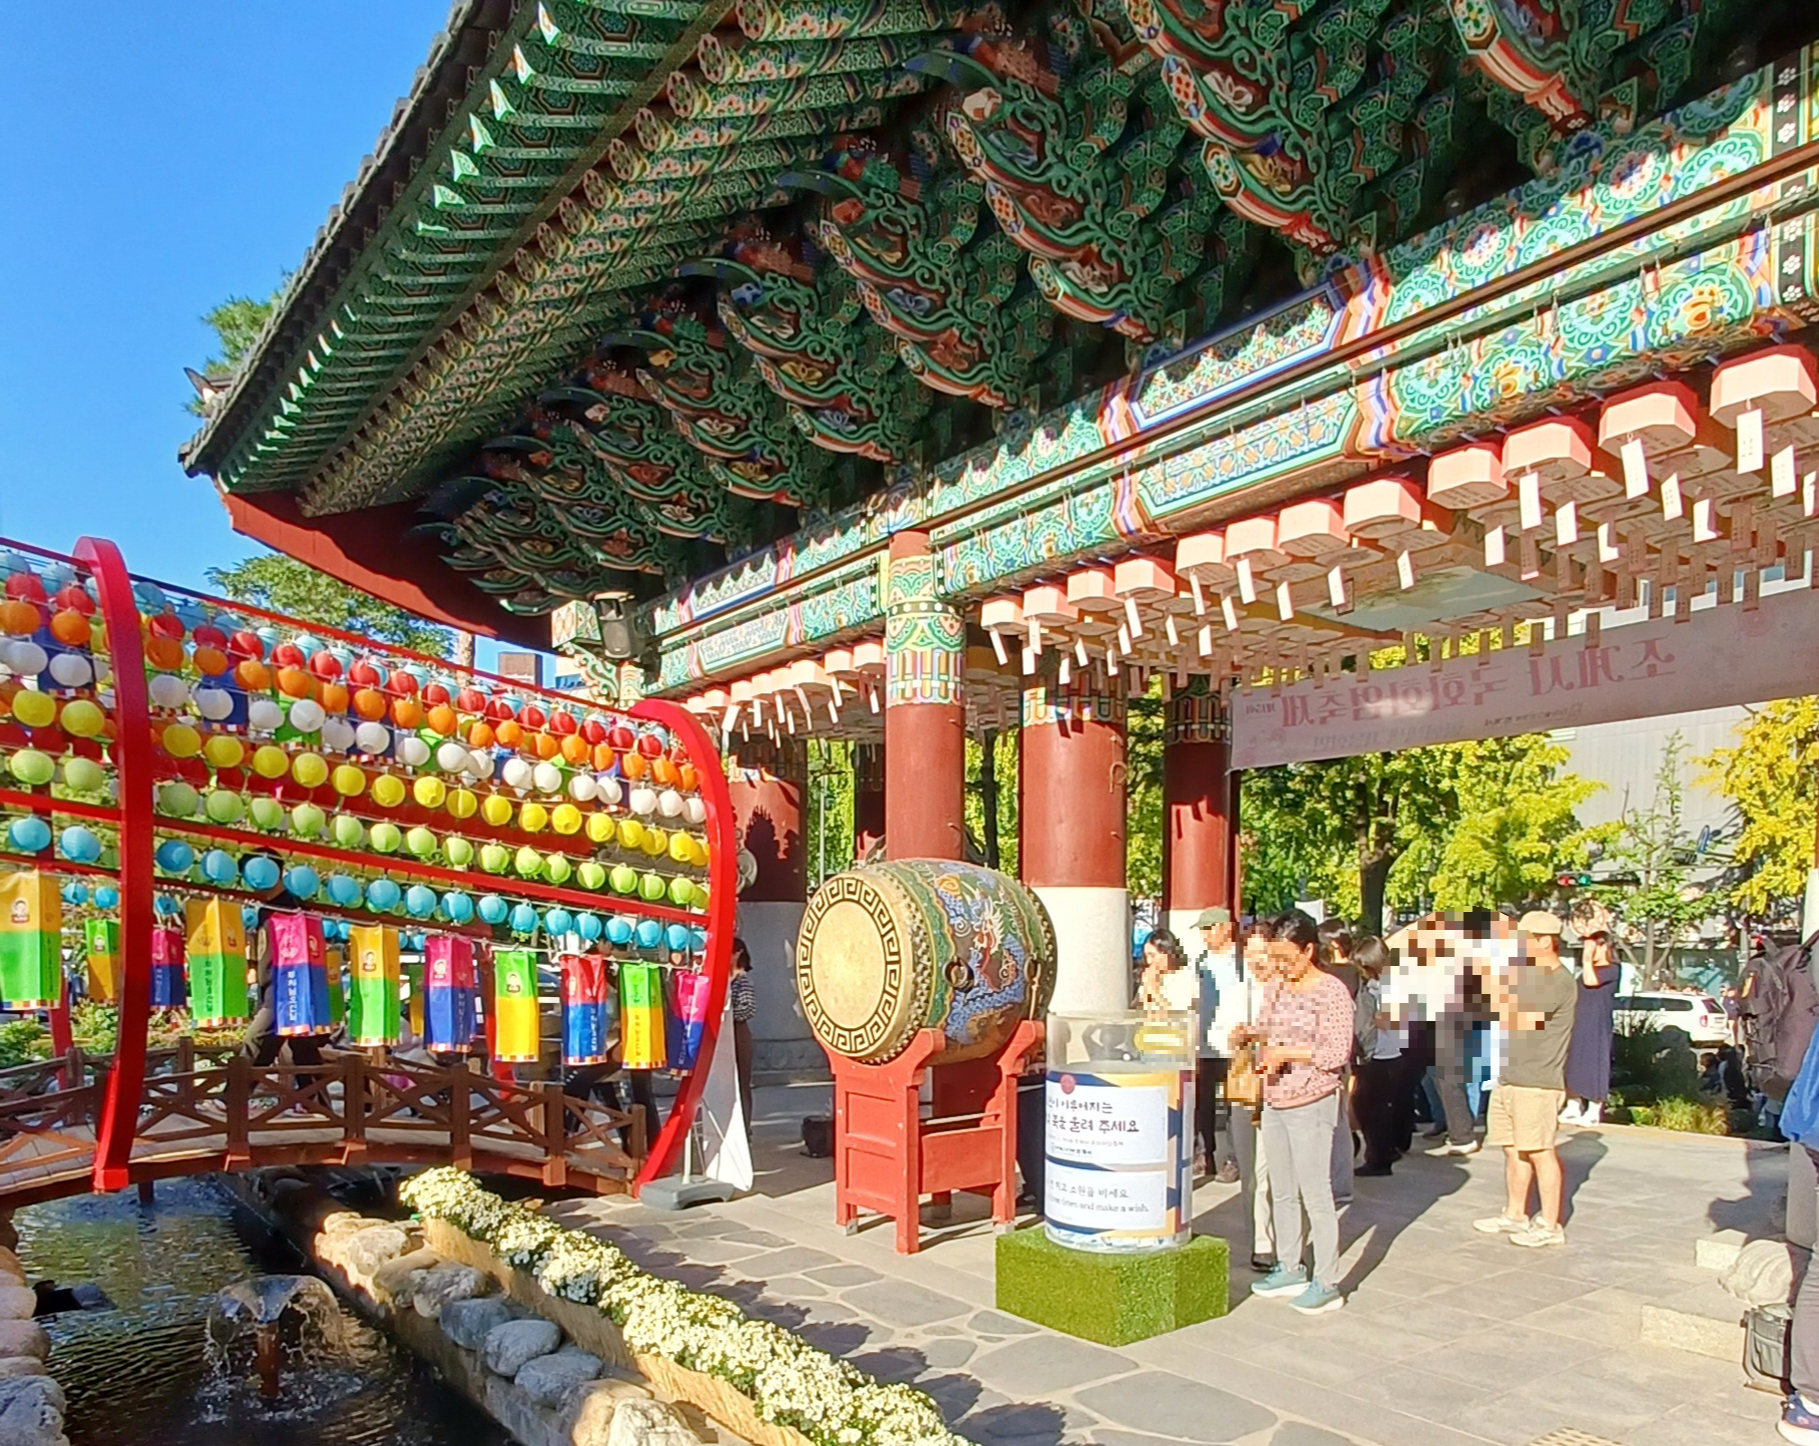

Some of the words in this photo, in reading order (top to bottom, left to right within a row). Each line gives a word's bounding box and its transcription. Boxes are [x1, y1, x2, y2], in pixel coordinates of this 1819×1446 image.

[1061, 1099, 1113, 1114] 이루어지는
[1069, 1116, 1094, 1133] 울려
[1098, 1120, 1140, 1134] 주세요
[1069, 1185, 1095, 1197] 소원을
[1098, 1188, 1130, 1198] 비세요
[1096, 1203, 1119, 1212] make
